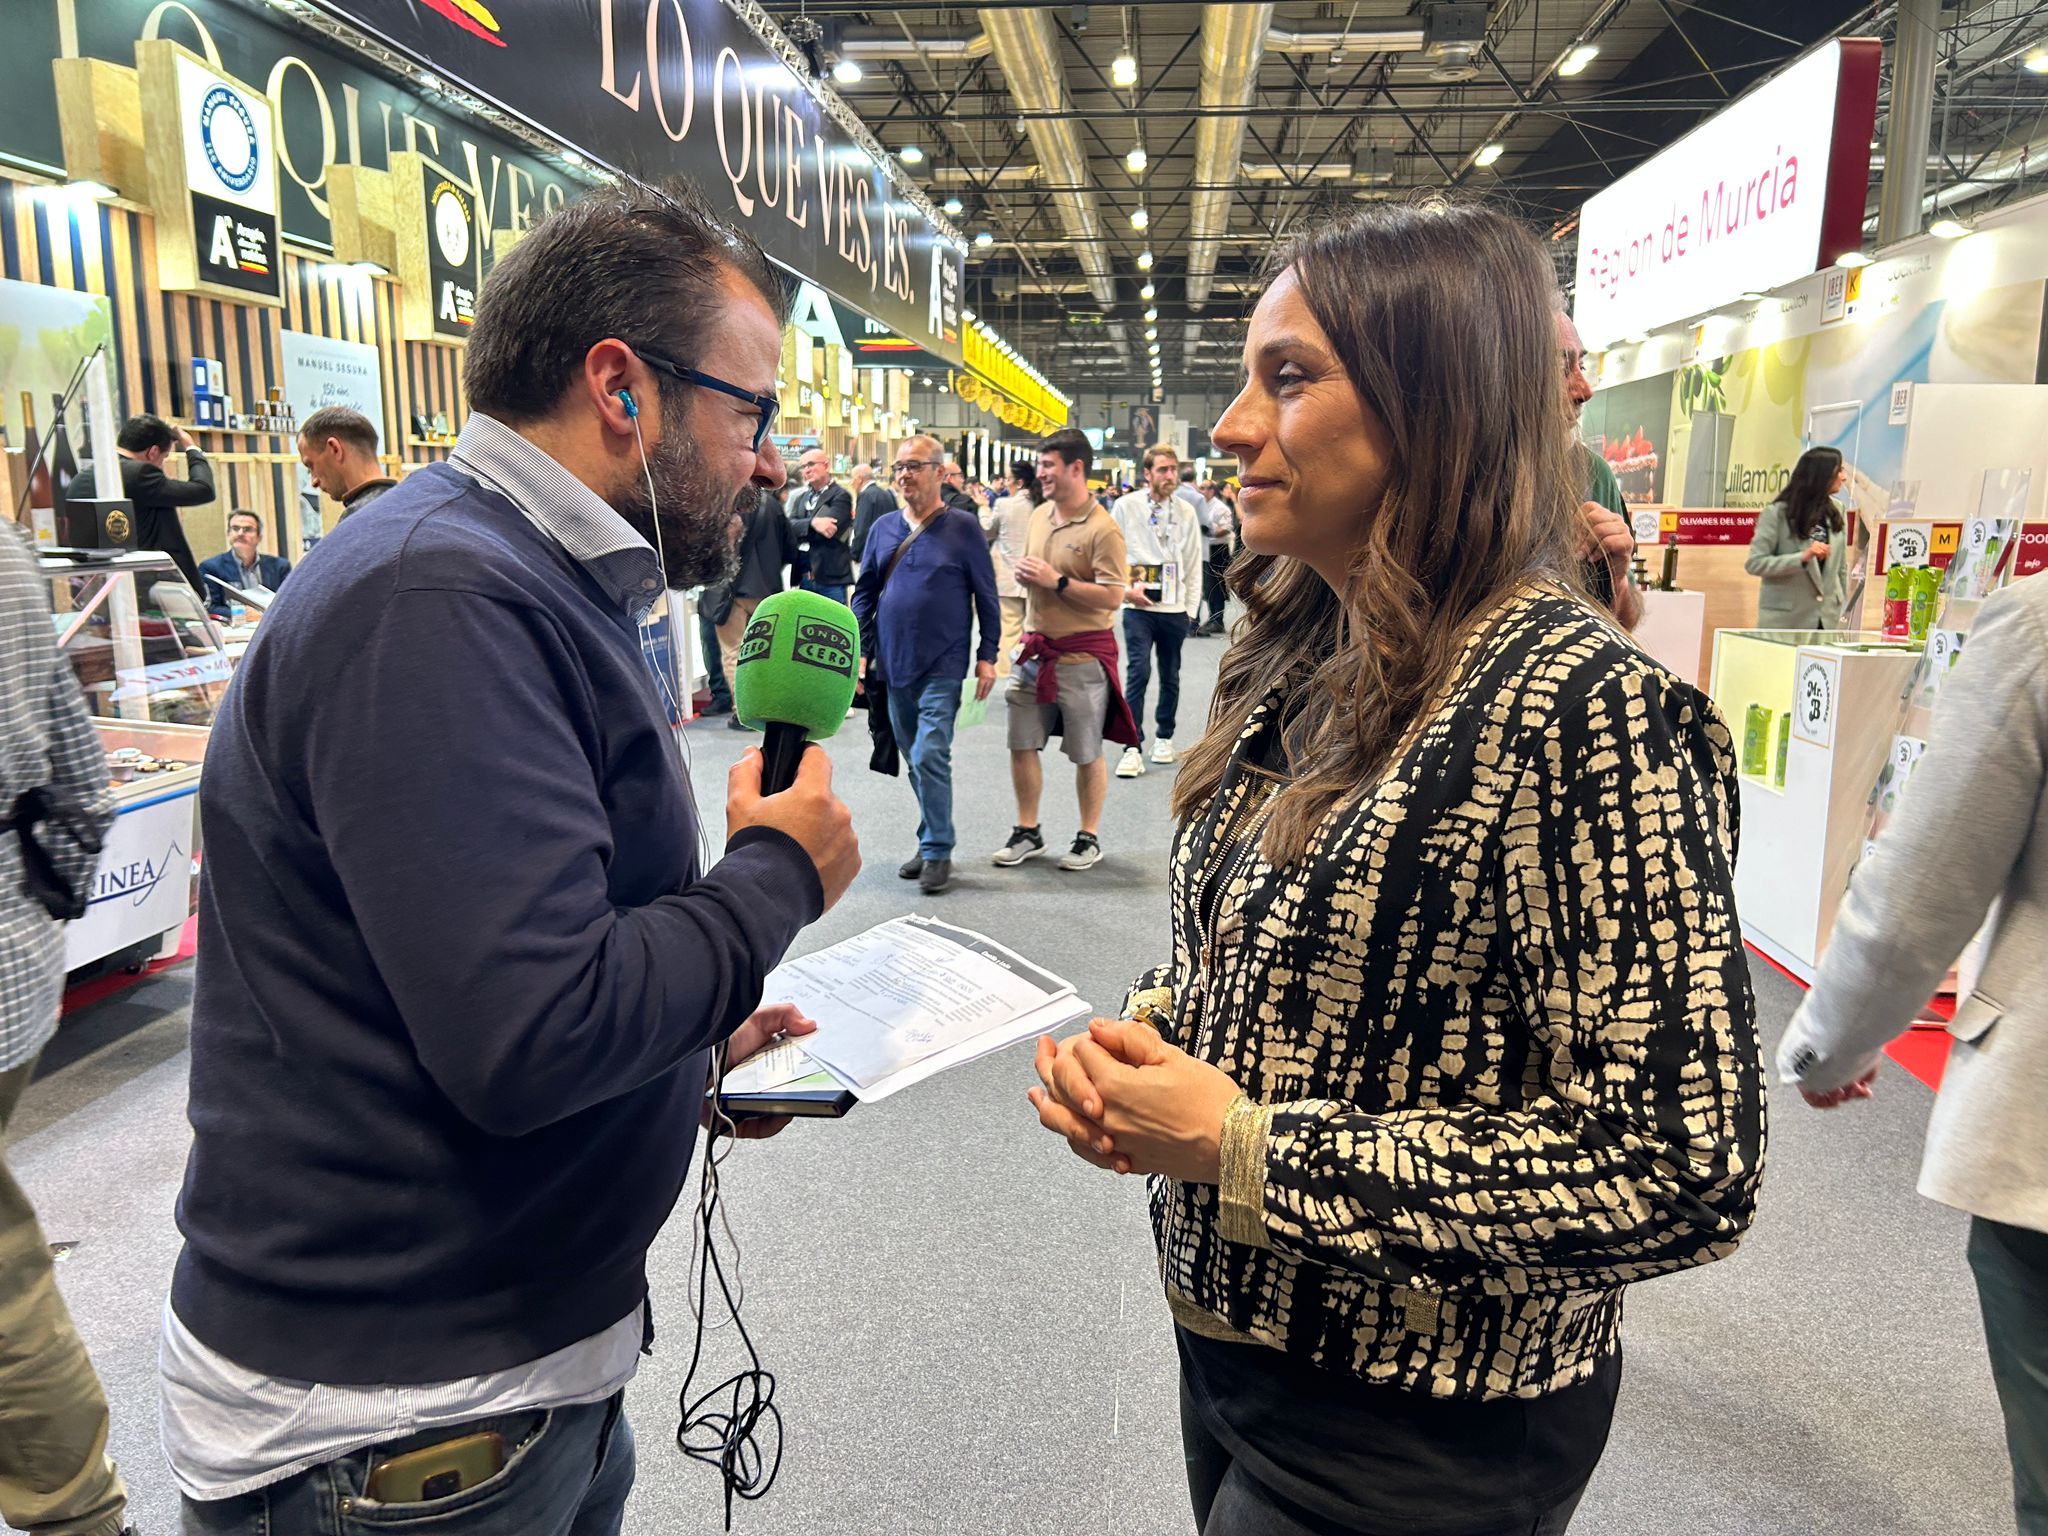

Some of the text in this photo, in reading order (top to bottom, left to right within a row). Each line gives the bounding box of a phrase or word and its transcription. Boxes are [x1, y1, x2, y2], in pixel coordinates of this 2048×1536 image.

[601, 0, 916, 305] LO QUE VES, ES.
[1661, 202, 1689, 263] de
[1849, 275, 1857, 293] K
[1679, 517, 1755, 527] OLIVARES DEL SUR
[1898, 537, 1918, 547] Mr.
[1939, 534, 1951, 544] M
[1902, 546, 1917, 559] B
[806, 626, 848, 647] ONDA
[806, 645, 847, 666] CERO
[1807, 680, 1823, 698] Mr.
[1808, 698, 1821, 722] B
